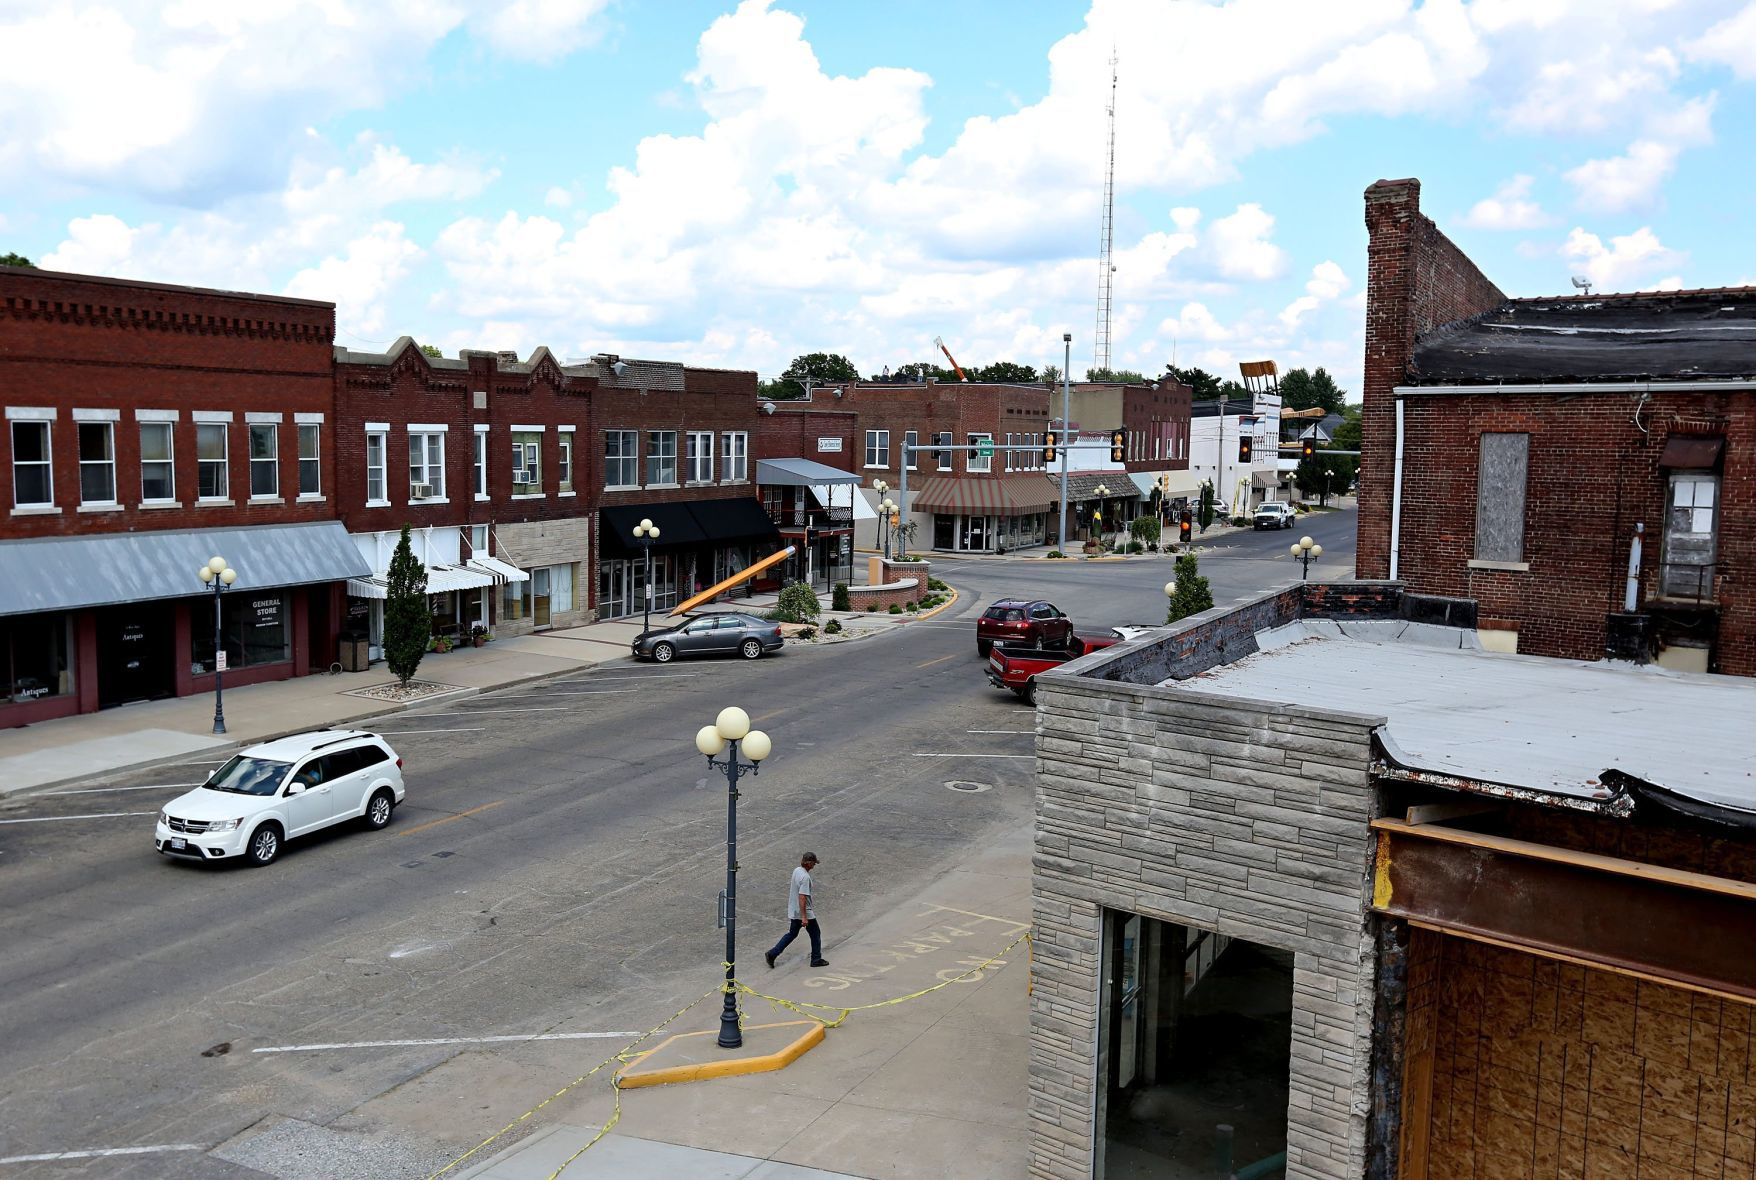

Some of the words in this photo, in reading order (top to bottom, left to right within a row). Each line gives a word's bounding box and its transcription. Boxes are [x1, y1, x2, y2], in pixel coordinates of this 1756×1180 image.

[252, 598, 280, 608] GENERAL
[256, 606, 277, 616] STORE
[122, 633, 144, 642] Antiques
[21, 687, 49, 698] Antiques
[936, 955, 1008, 983] NO
